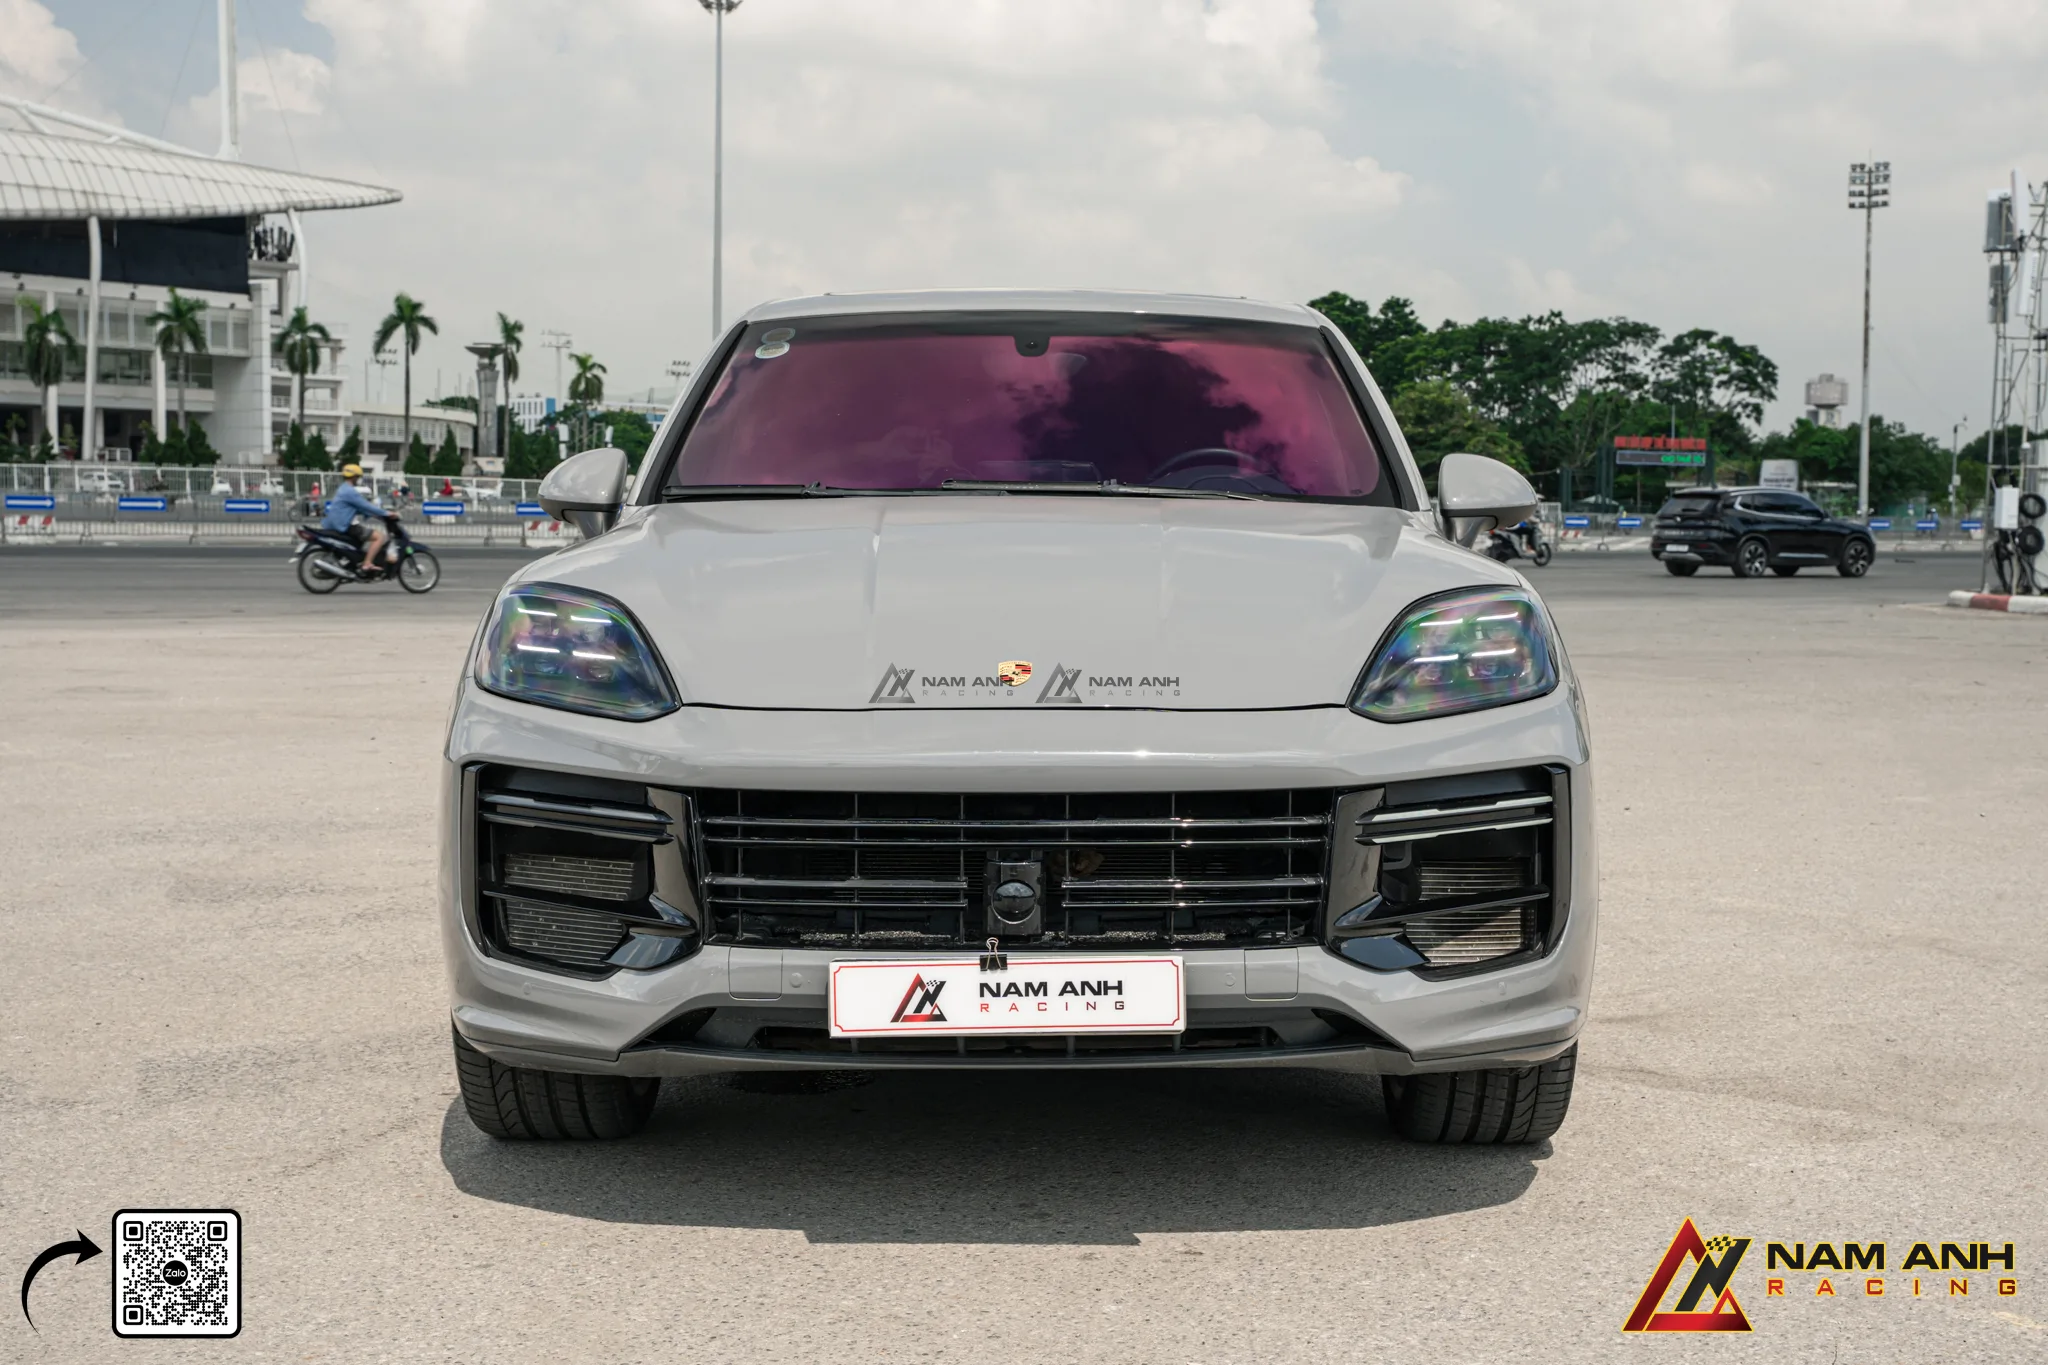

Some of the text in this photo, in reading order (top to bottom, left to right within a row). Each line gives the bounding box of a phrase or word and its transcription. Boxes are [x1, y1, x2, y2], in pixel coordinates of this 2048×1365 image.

[979, 980, 1123, 998] NAM ANH
[979, 1001, 1125, 1012] RACING
